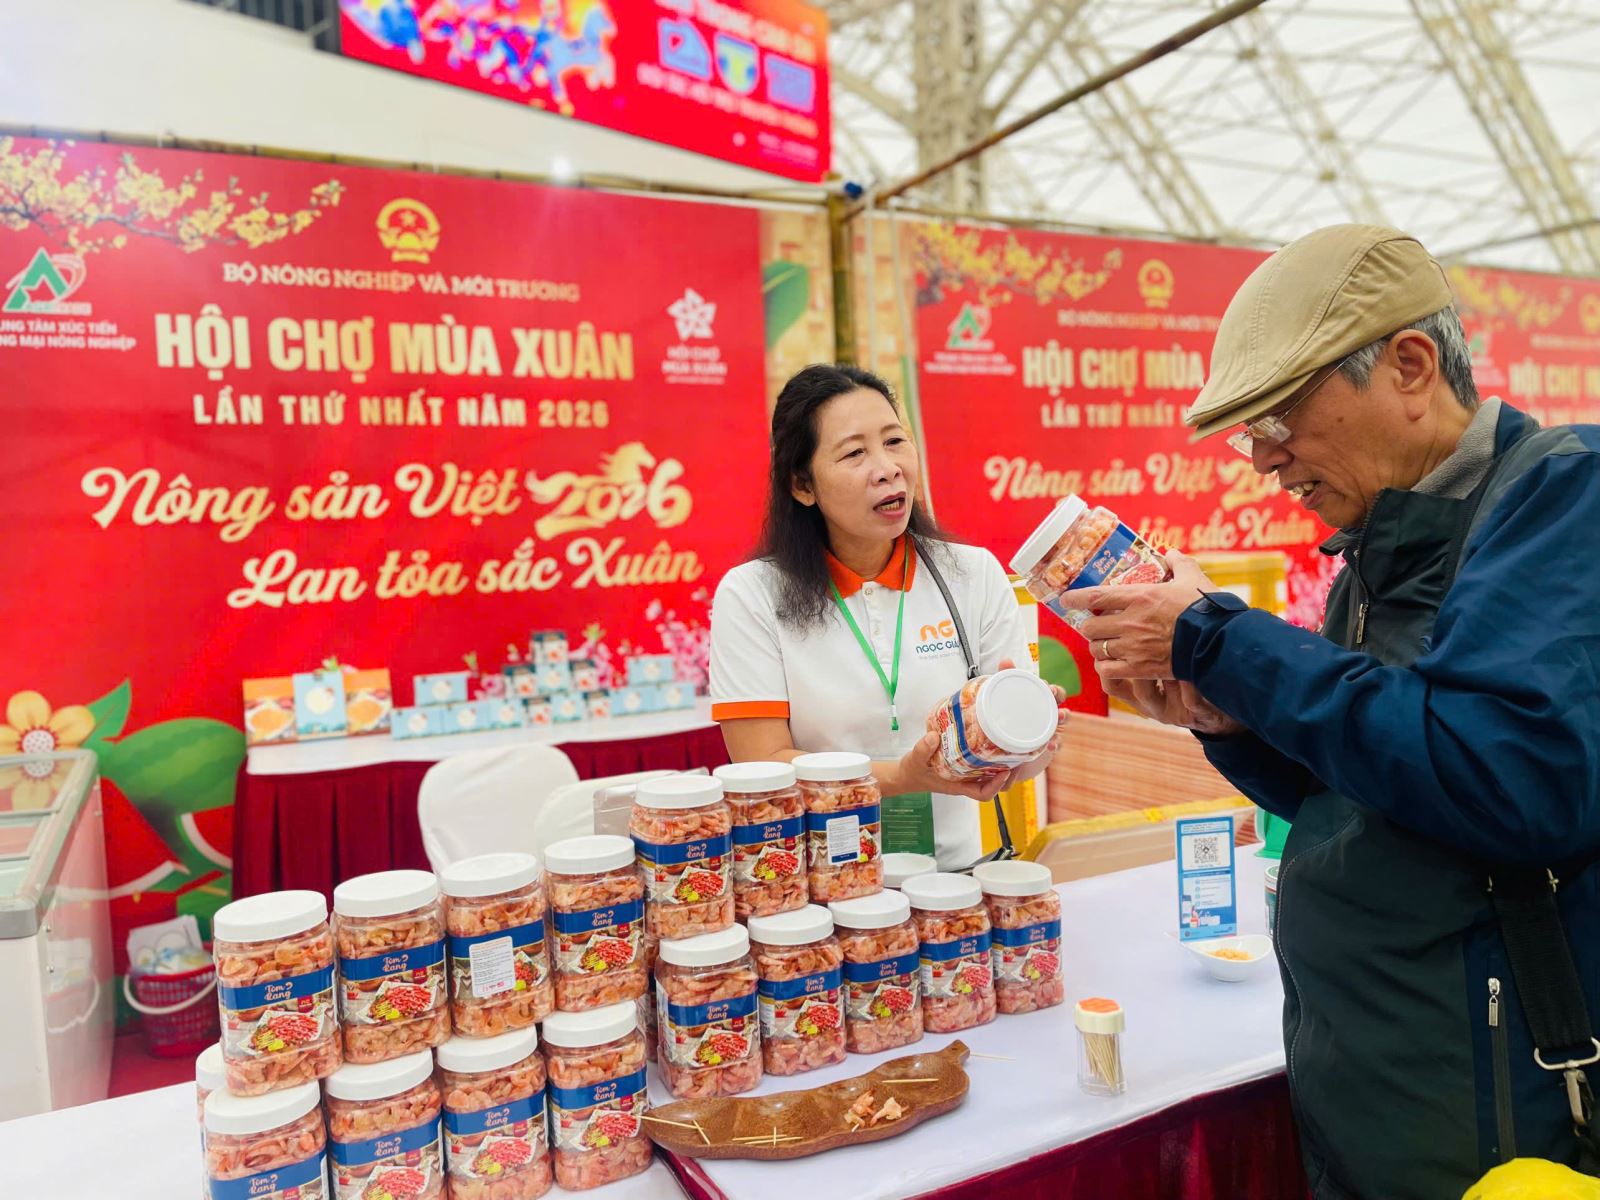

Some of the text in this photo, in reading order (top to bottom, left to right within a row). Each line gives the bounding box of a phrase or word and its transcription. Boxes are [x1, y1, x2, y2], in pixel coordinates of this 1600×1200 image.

[260, 262, 331, 287] NÔNG
[155, 303, 634, 384] HỘI CHỢ MÙA XUÂN
[1023, 339, 1205, 397] HỘI CHỢ MÙA
[279, 390, 346, 426] THỨ
[359, 388, 445, 427] NHẤT
[457, 392, 527, 427] NĂM
[538, 399, 609, 428] 2026
[81, 450, 693, 543] Nông sản Việt 2026
[226, 537, 704, 609] Lan tỏa sắc Xuân
